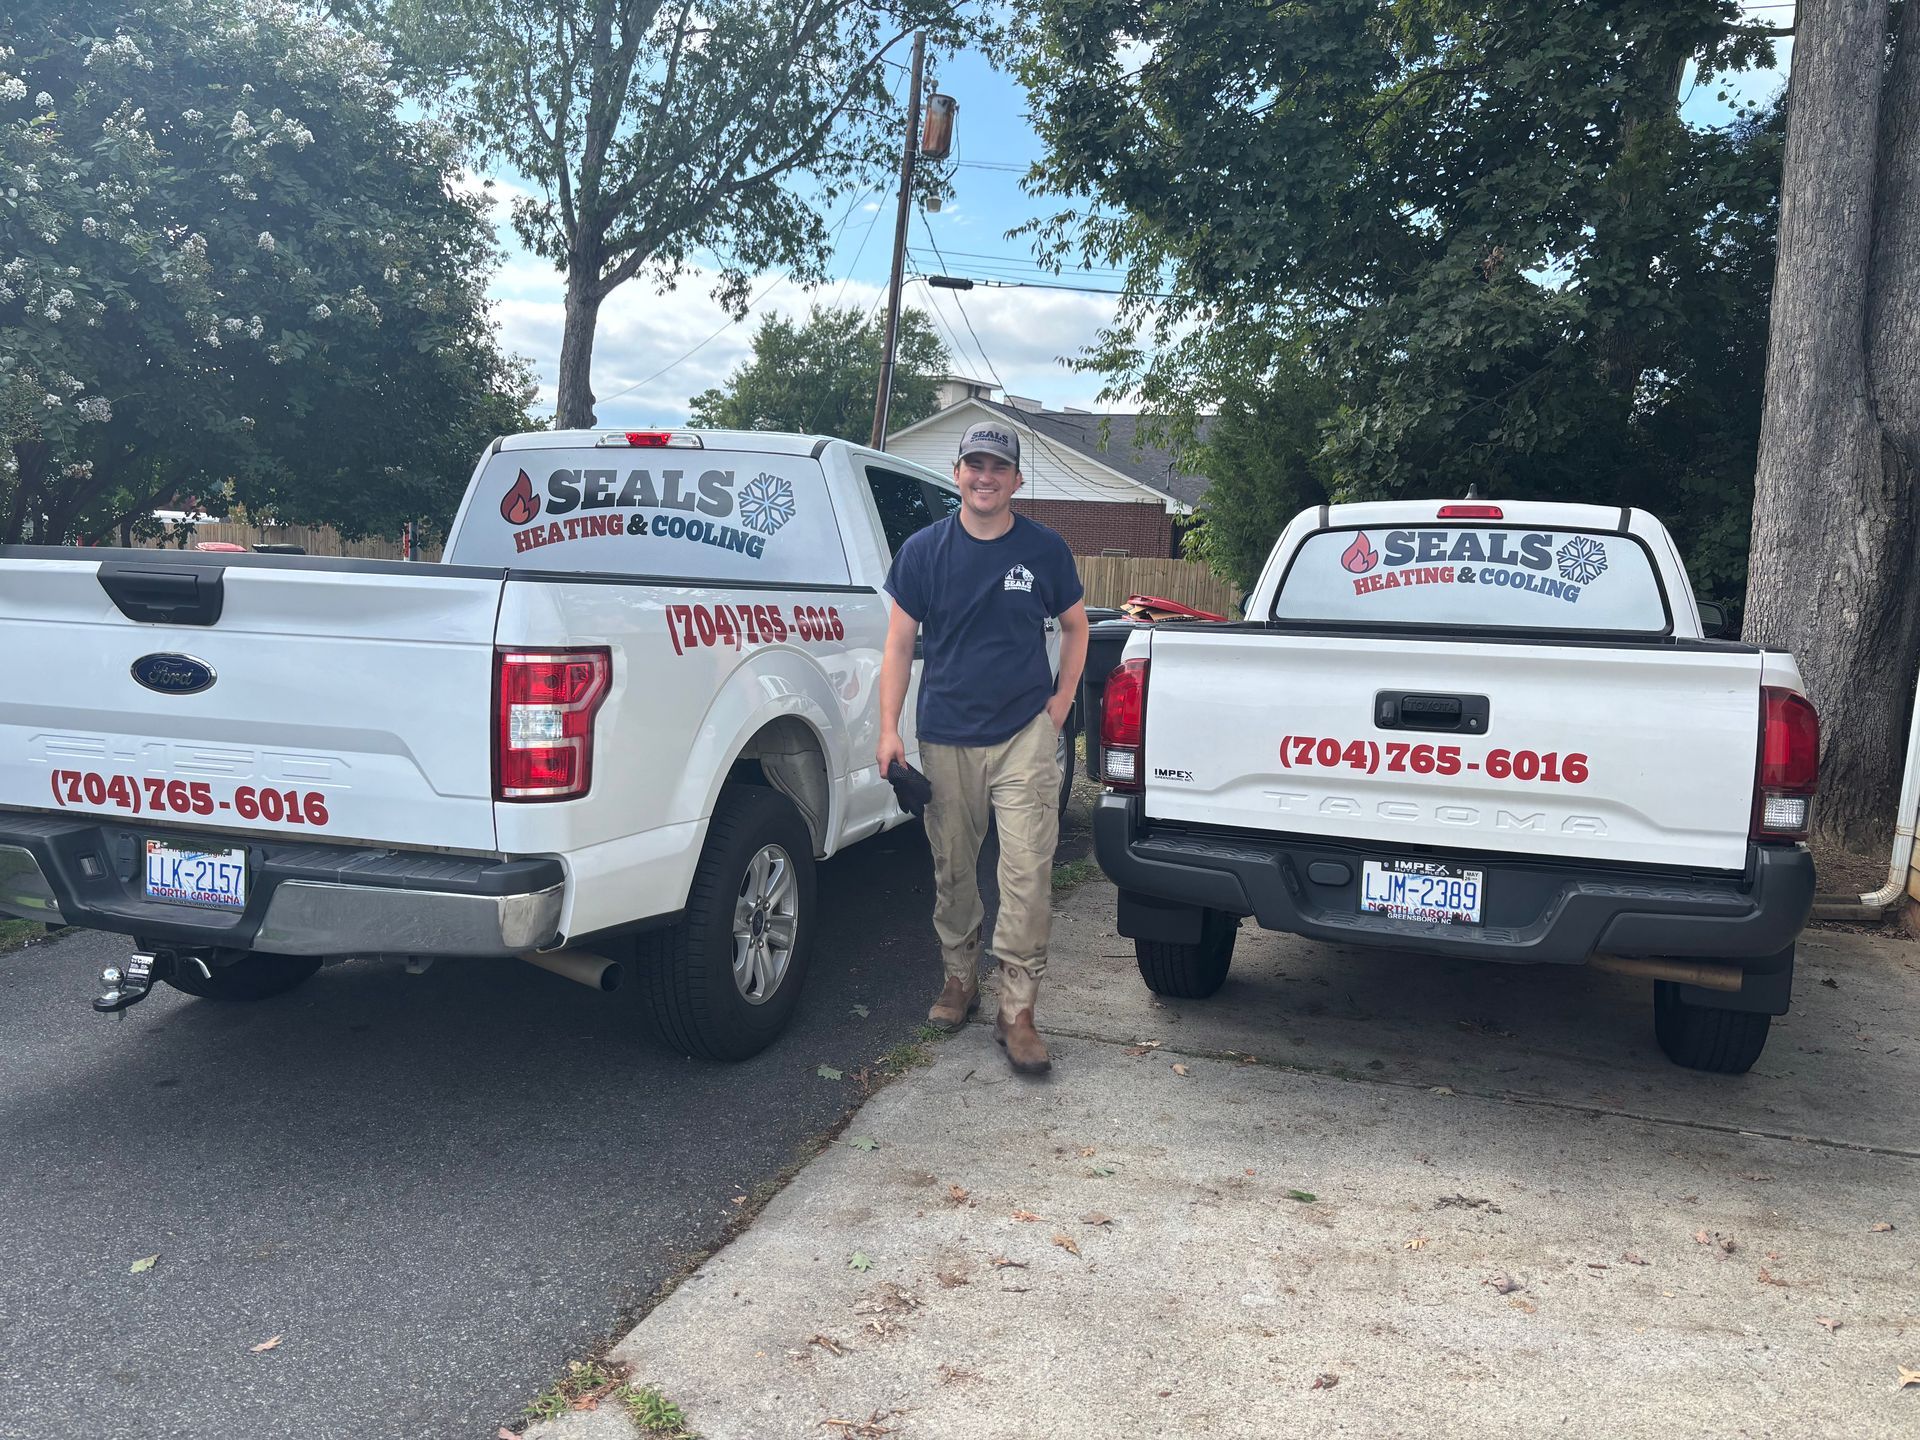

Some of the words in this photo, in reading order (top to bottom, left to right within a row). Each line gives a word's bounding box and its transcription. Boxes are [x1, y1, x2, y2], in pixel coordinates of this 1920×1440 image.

[971, 430, 1008, 444] SEALS
[546, 469, 735, 517] SEALS
[513, 514, 623, 553] HEATING
[627, 513, 648, 536] &
[652, 515, 766, 559] COOLING
[1383, 530, 1553, 570] SEALS
[1004, 580, 1032, 588] SEALS
[1353, 566, 1454, 595] HEATING
[1457, 567, 1475, 583] &
[1479, 568, 1581, 603] COOLING
[148, 660, 193, 685] Ford
[1407, 700, 1458, 712] TOYOTA
[1154, 768, 1194, 782] IMPEX
[1263, 790, 1608, 837] TACOMA
[149, 855, 243, 895] LLK-2157
[1394, 860, 1450, 875] IMPEX
[152, 887, 187, 899] NORTH
[191, 891, 240, 905] CAROLINA
[1366, 872, 1477, 910] LJM-2389
[1368, 902, 1409, 914] NORTH
[1387, 912, 1439, 924] GREENSBORO,
